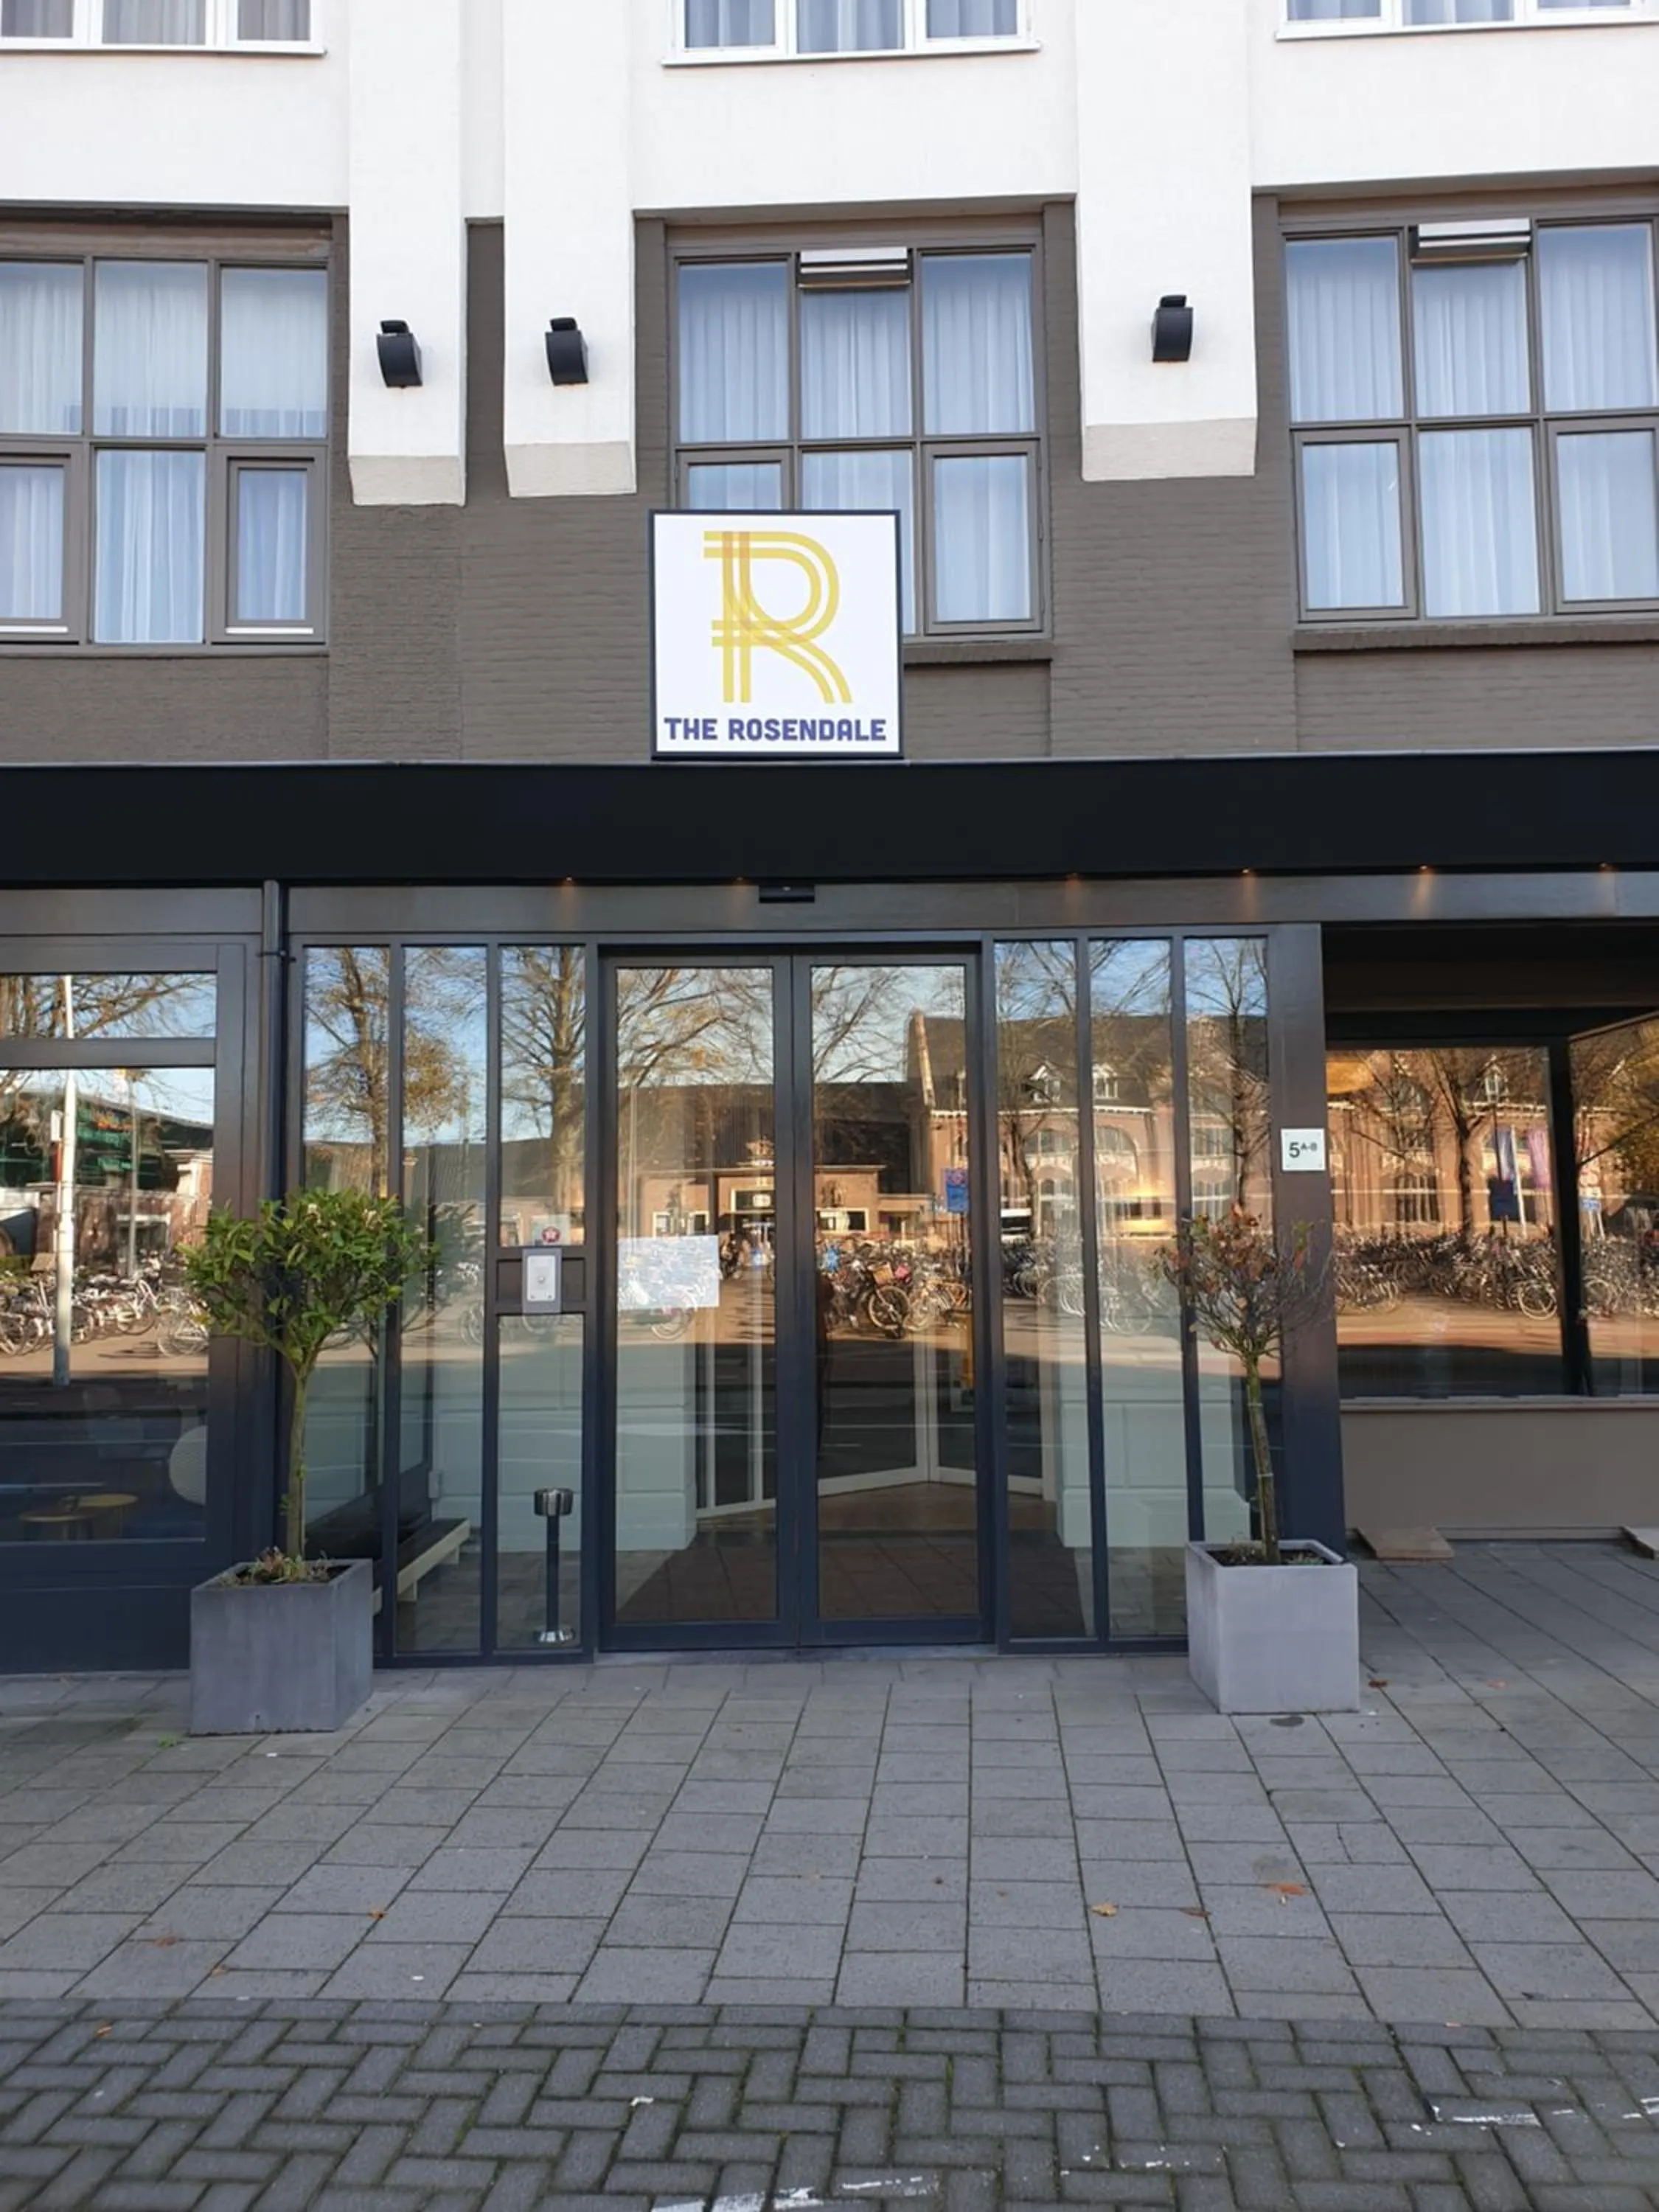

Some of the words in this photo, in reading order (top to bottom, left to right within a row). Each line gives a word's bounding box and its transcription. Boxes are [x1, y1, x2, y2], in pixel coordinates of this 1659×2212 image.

[703, 531, 853, 703] R
[664, 717, 717, 740] THE
[728, 719, 886, 741] ROSENDALE
